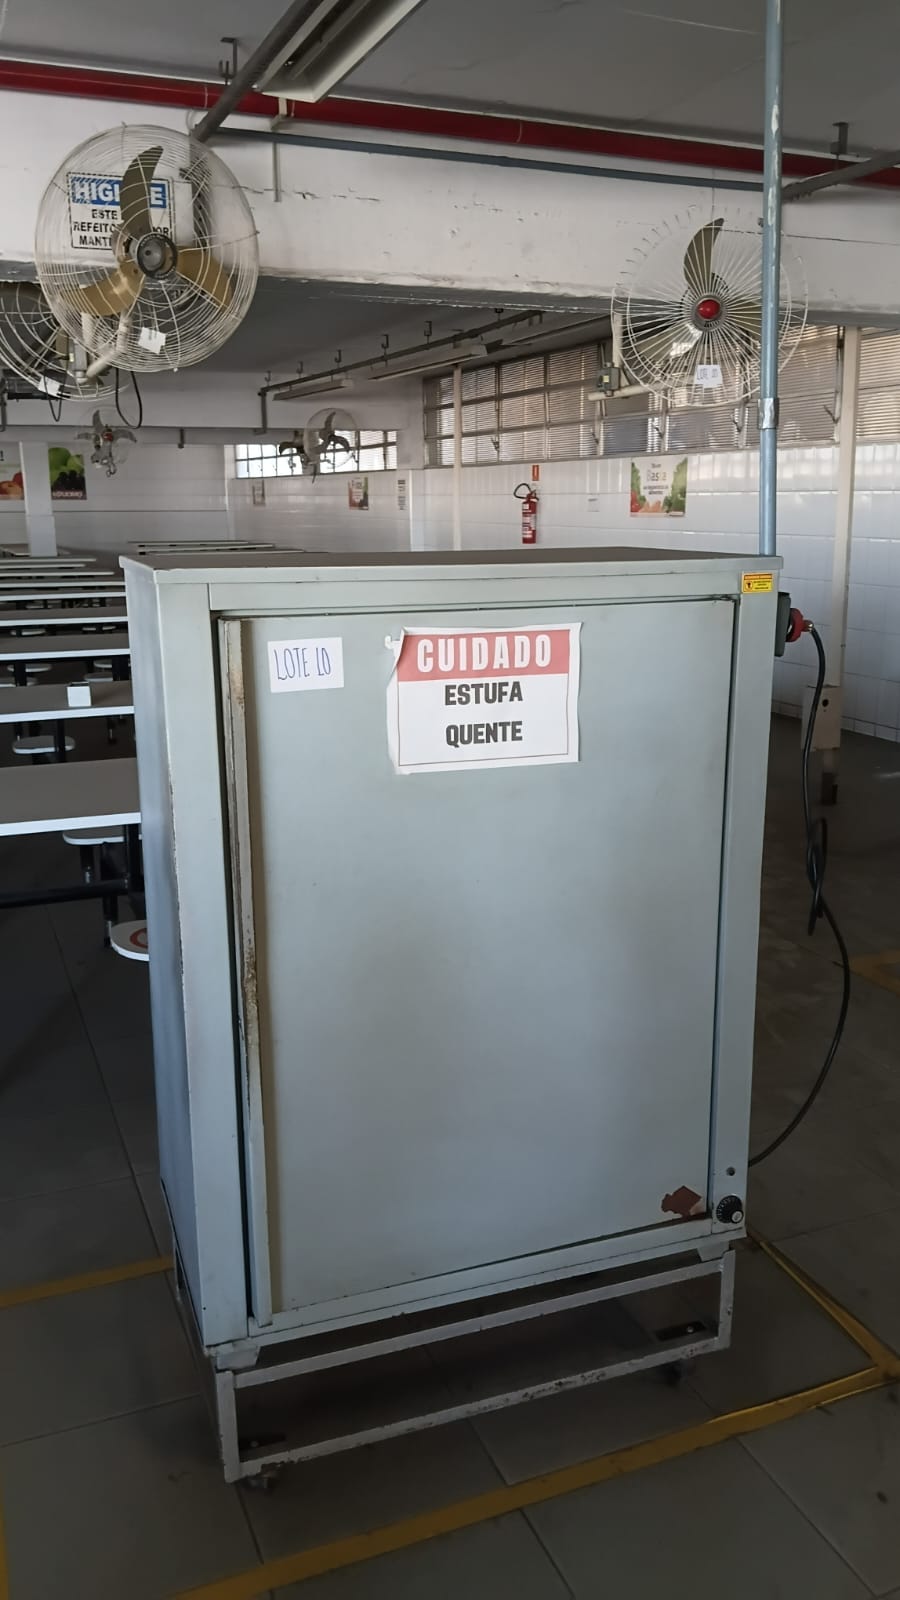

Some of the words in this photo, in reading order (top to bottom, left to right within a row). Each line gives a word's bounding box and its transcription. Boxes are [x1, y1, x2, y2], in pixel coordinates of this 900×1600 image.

[74, 181, 163, 205] HIGIE
[74, 221, 117, 233] REFEITO
[92, 209, 118, 220] ESTE
[274, 647, 310, 680] LOTE
[417, 634, 551, 673] CUIDADO
[445, 681, 523, 706] ESTUFA
[446, 720, 523, 748] QUENTE
